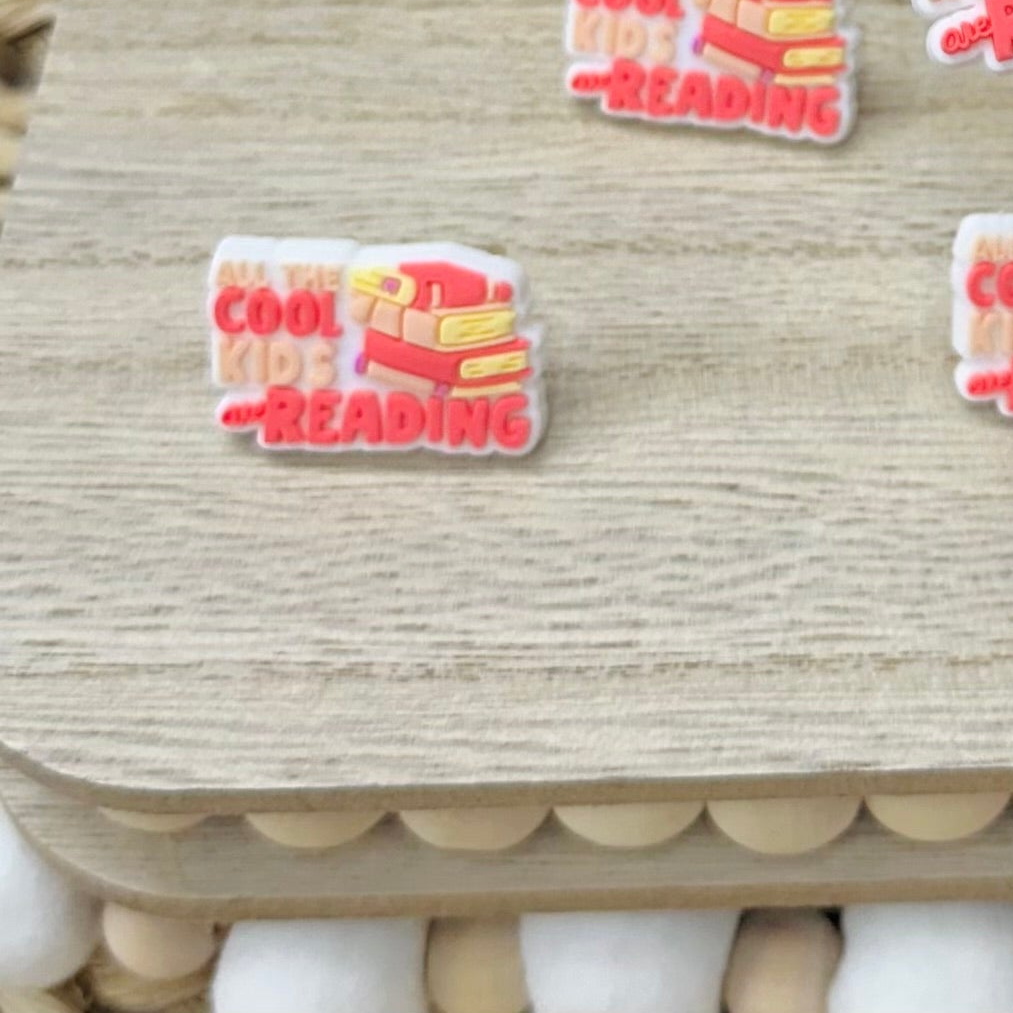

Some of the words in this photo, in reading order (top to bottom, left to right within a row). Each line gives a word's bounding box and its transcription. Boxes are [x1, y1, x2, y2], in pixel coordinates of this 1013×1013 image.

[572, 9, 676, 64] KIDS
[941, 13, 993, 54] are
[607, 58, 839, 136] READING
[283, 264, 340, 291] THE
[214, 287, 342, 338] COOL
[218, 338, 337, 386] KIDS
[264, 386, 529, 448] READING
